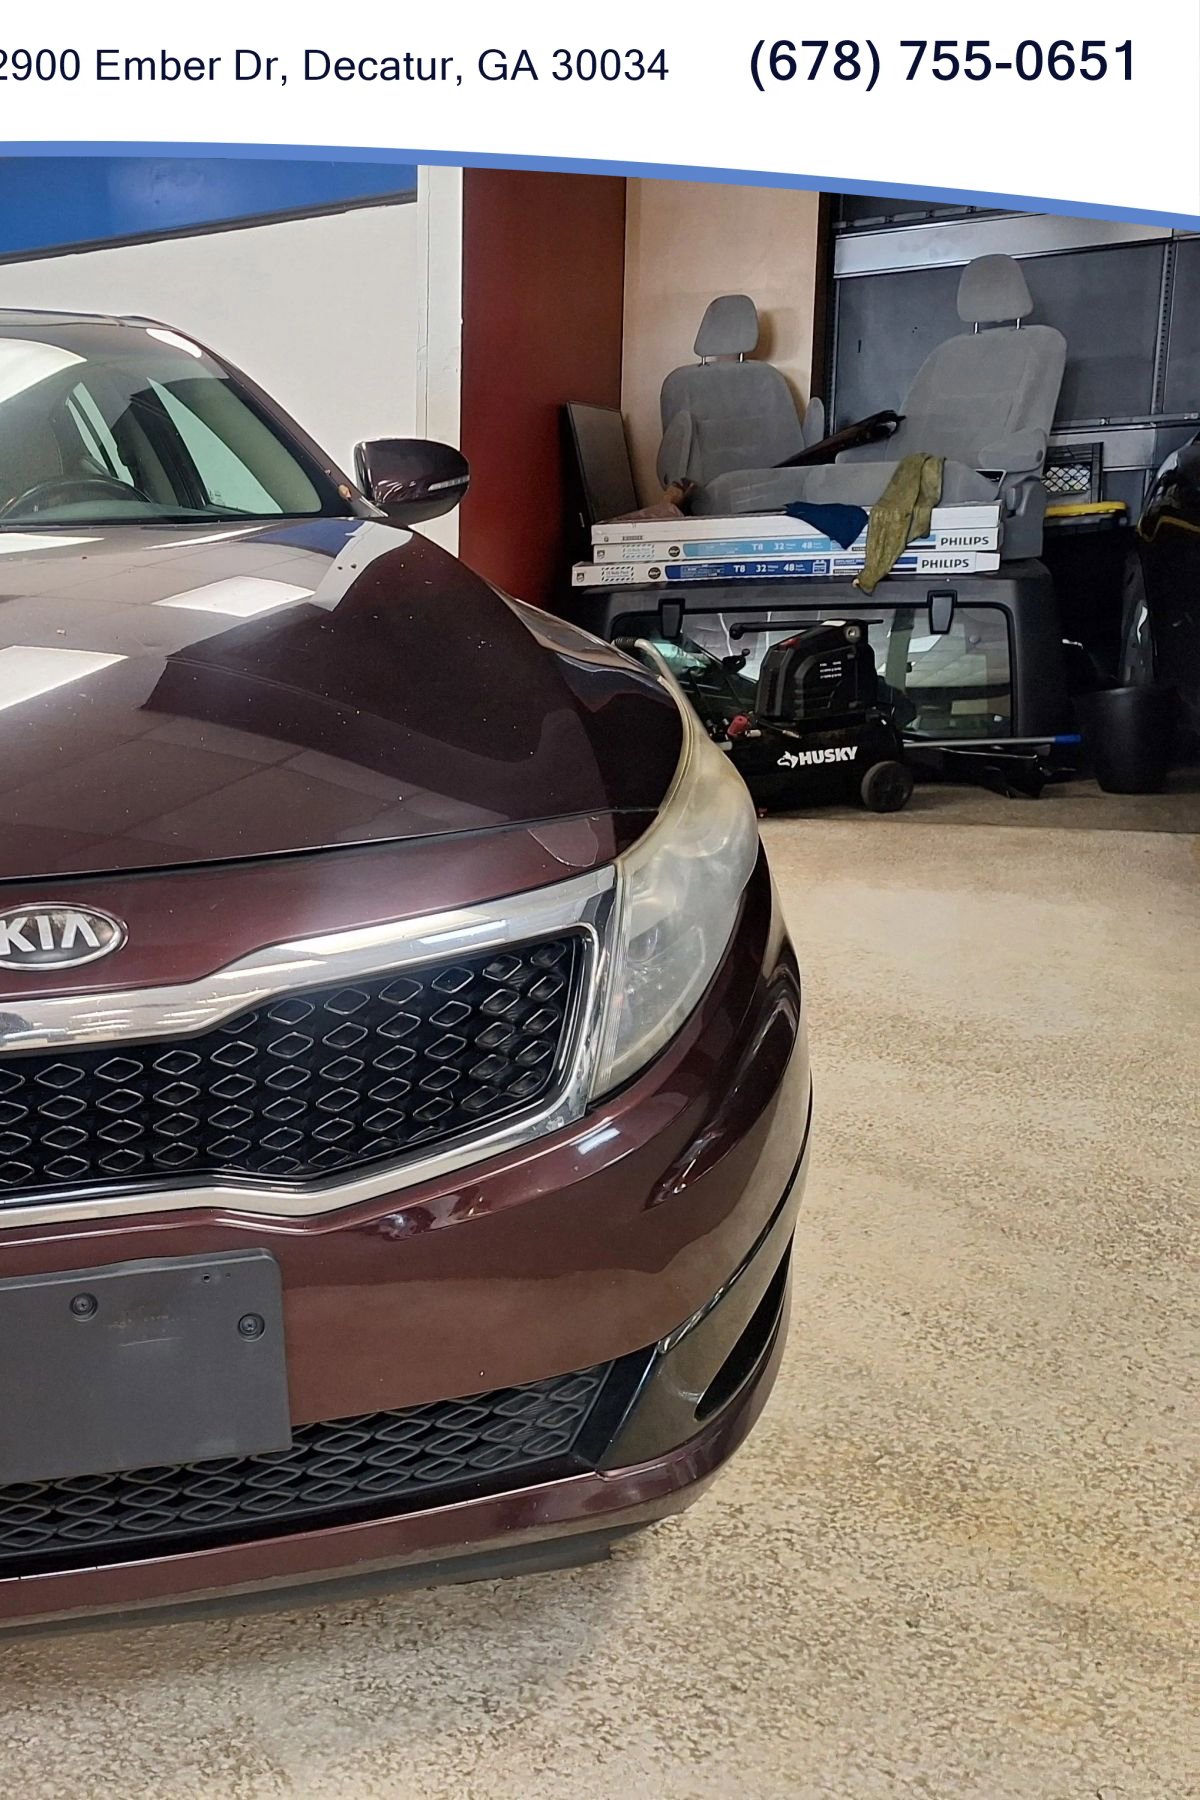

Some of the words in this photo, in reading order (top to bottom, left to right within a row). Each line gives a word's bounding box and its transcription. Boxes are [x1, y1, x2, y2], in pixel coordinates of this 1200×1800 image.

[940, 536, 990, 546] PHILIPS
[734, 564, 746, 573] T8
[755, 564, 767, 573] 32
[783, 563, 795, 572] 48
[921, 558, 970, 569] PHILIPS
[798, 746, 858, 766] HUSKY
